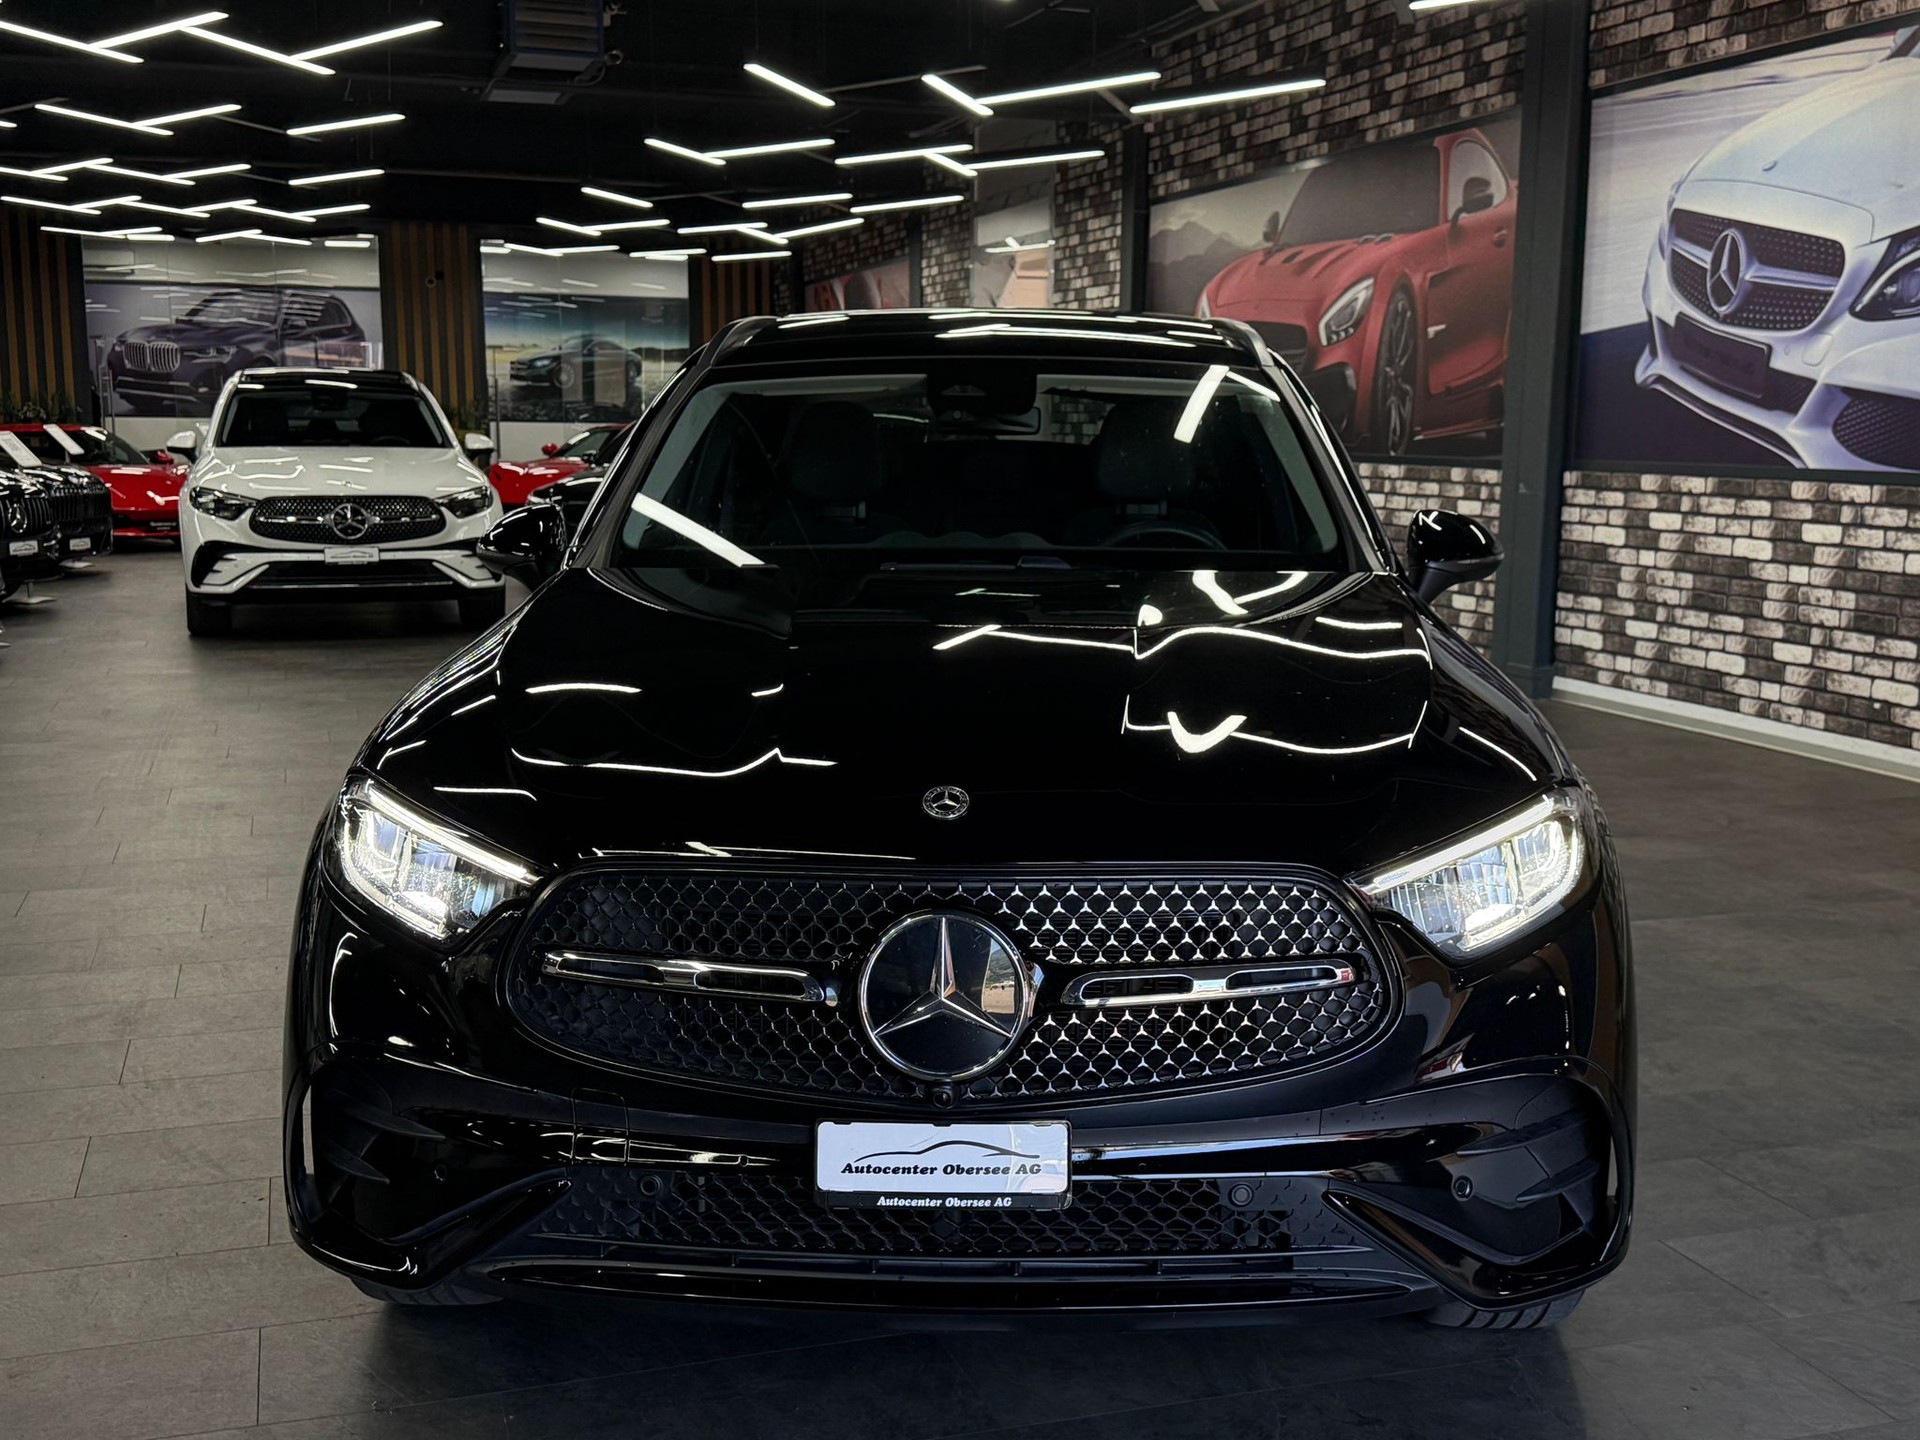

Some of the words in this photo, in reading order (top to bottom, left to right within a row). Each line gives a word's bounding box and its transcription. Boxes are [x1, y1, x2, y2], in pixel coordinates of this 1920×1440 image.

[841, 1163, 938, 1175] Autocenter
[942, 1164, 1011, 1175] Obersee
[1014, 1163, 1042, 1175] AG
[876, 1196, 943, 1207] Autocenter
[944, 1197, 992, 1208] Obersee
[995, 1197, 1013, 1208] AG
